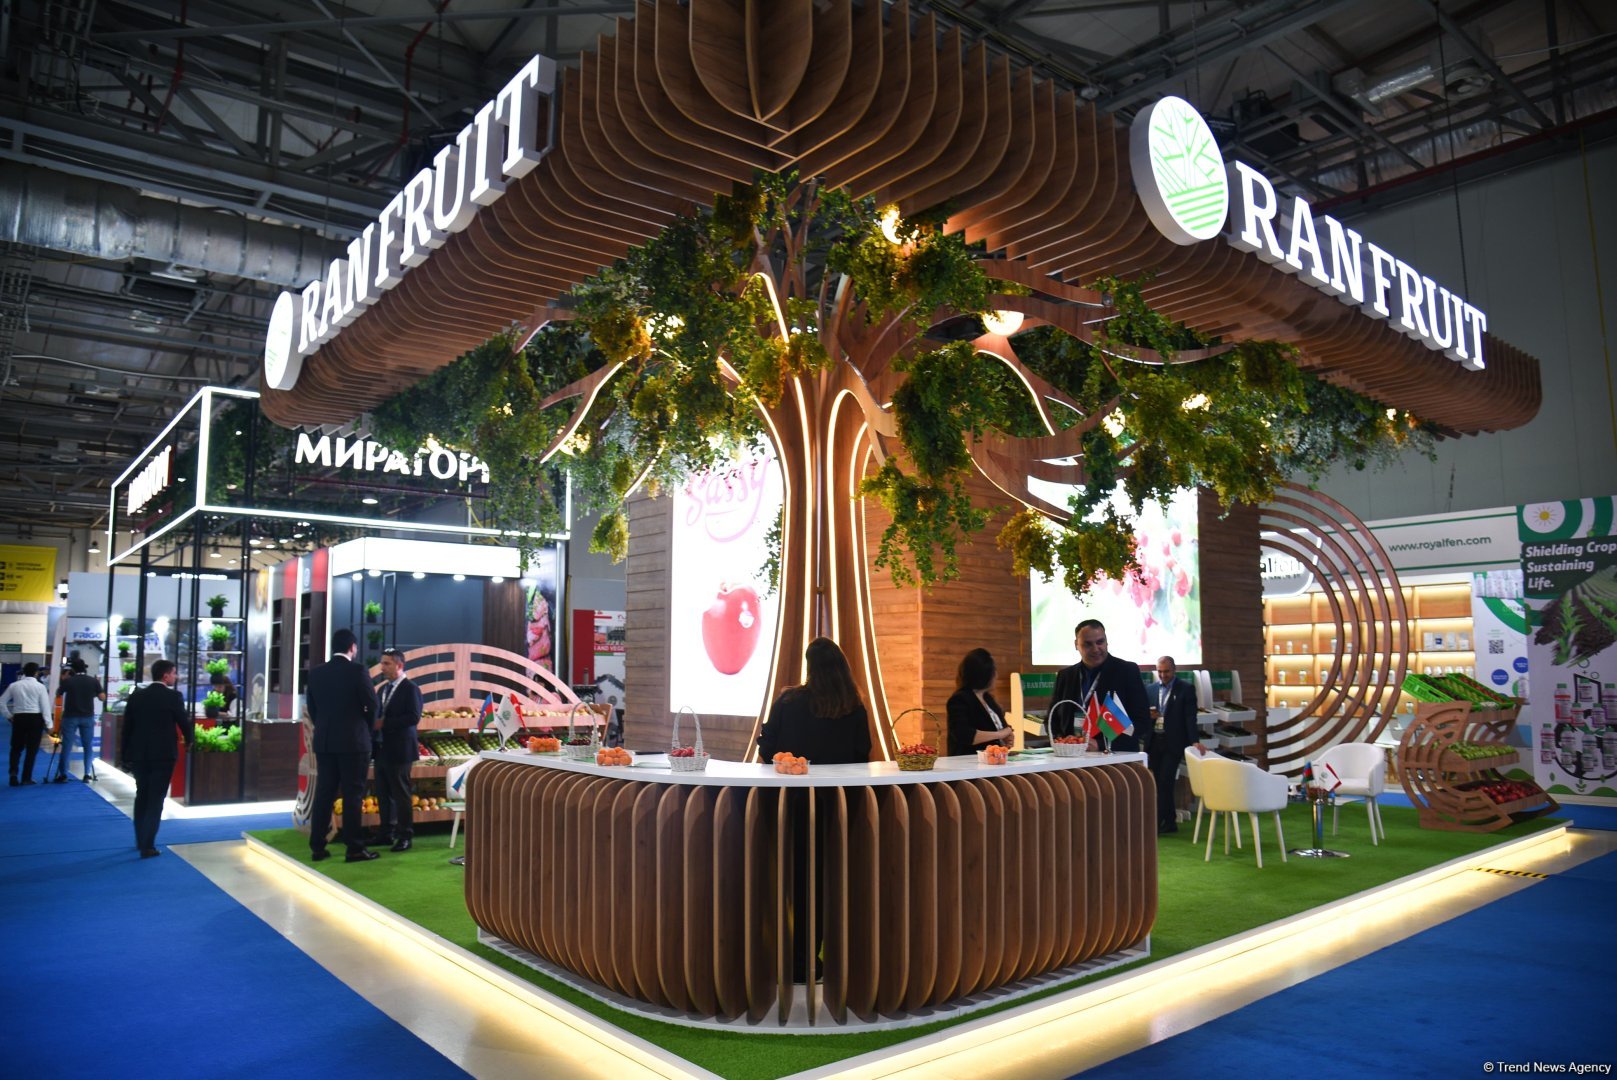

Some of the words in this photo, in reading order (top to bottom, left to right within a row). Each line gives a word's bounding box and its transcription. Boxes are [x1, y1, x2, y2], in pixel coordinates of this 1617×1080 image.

[1388, 536, 1492, 552] www.royalfen.com
[1525, 544, 1583, 558] Shielding
[1526, 559, 1595, 573] Sustaining
[1528, 576, 1555, 590] Life.
